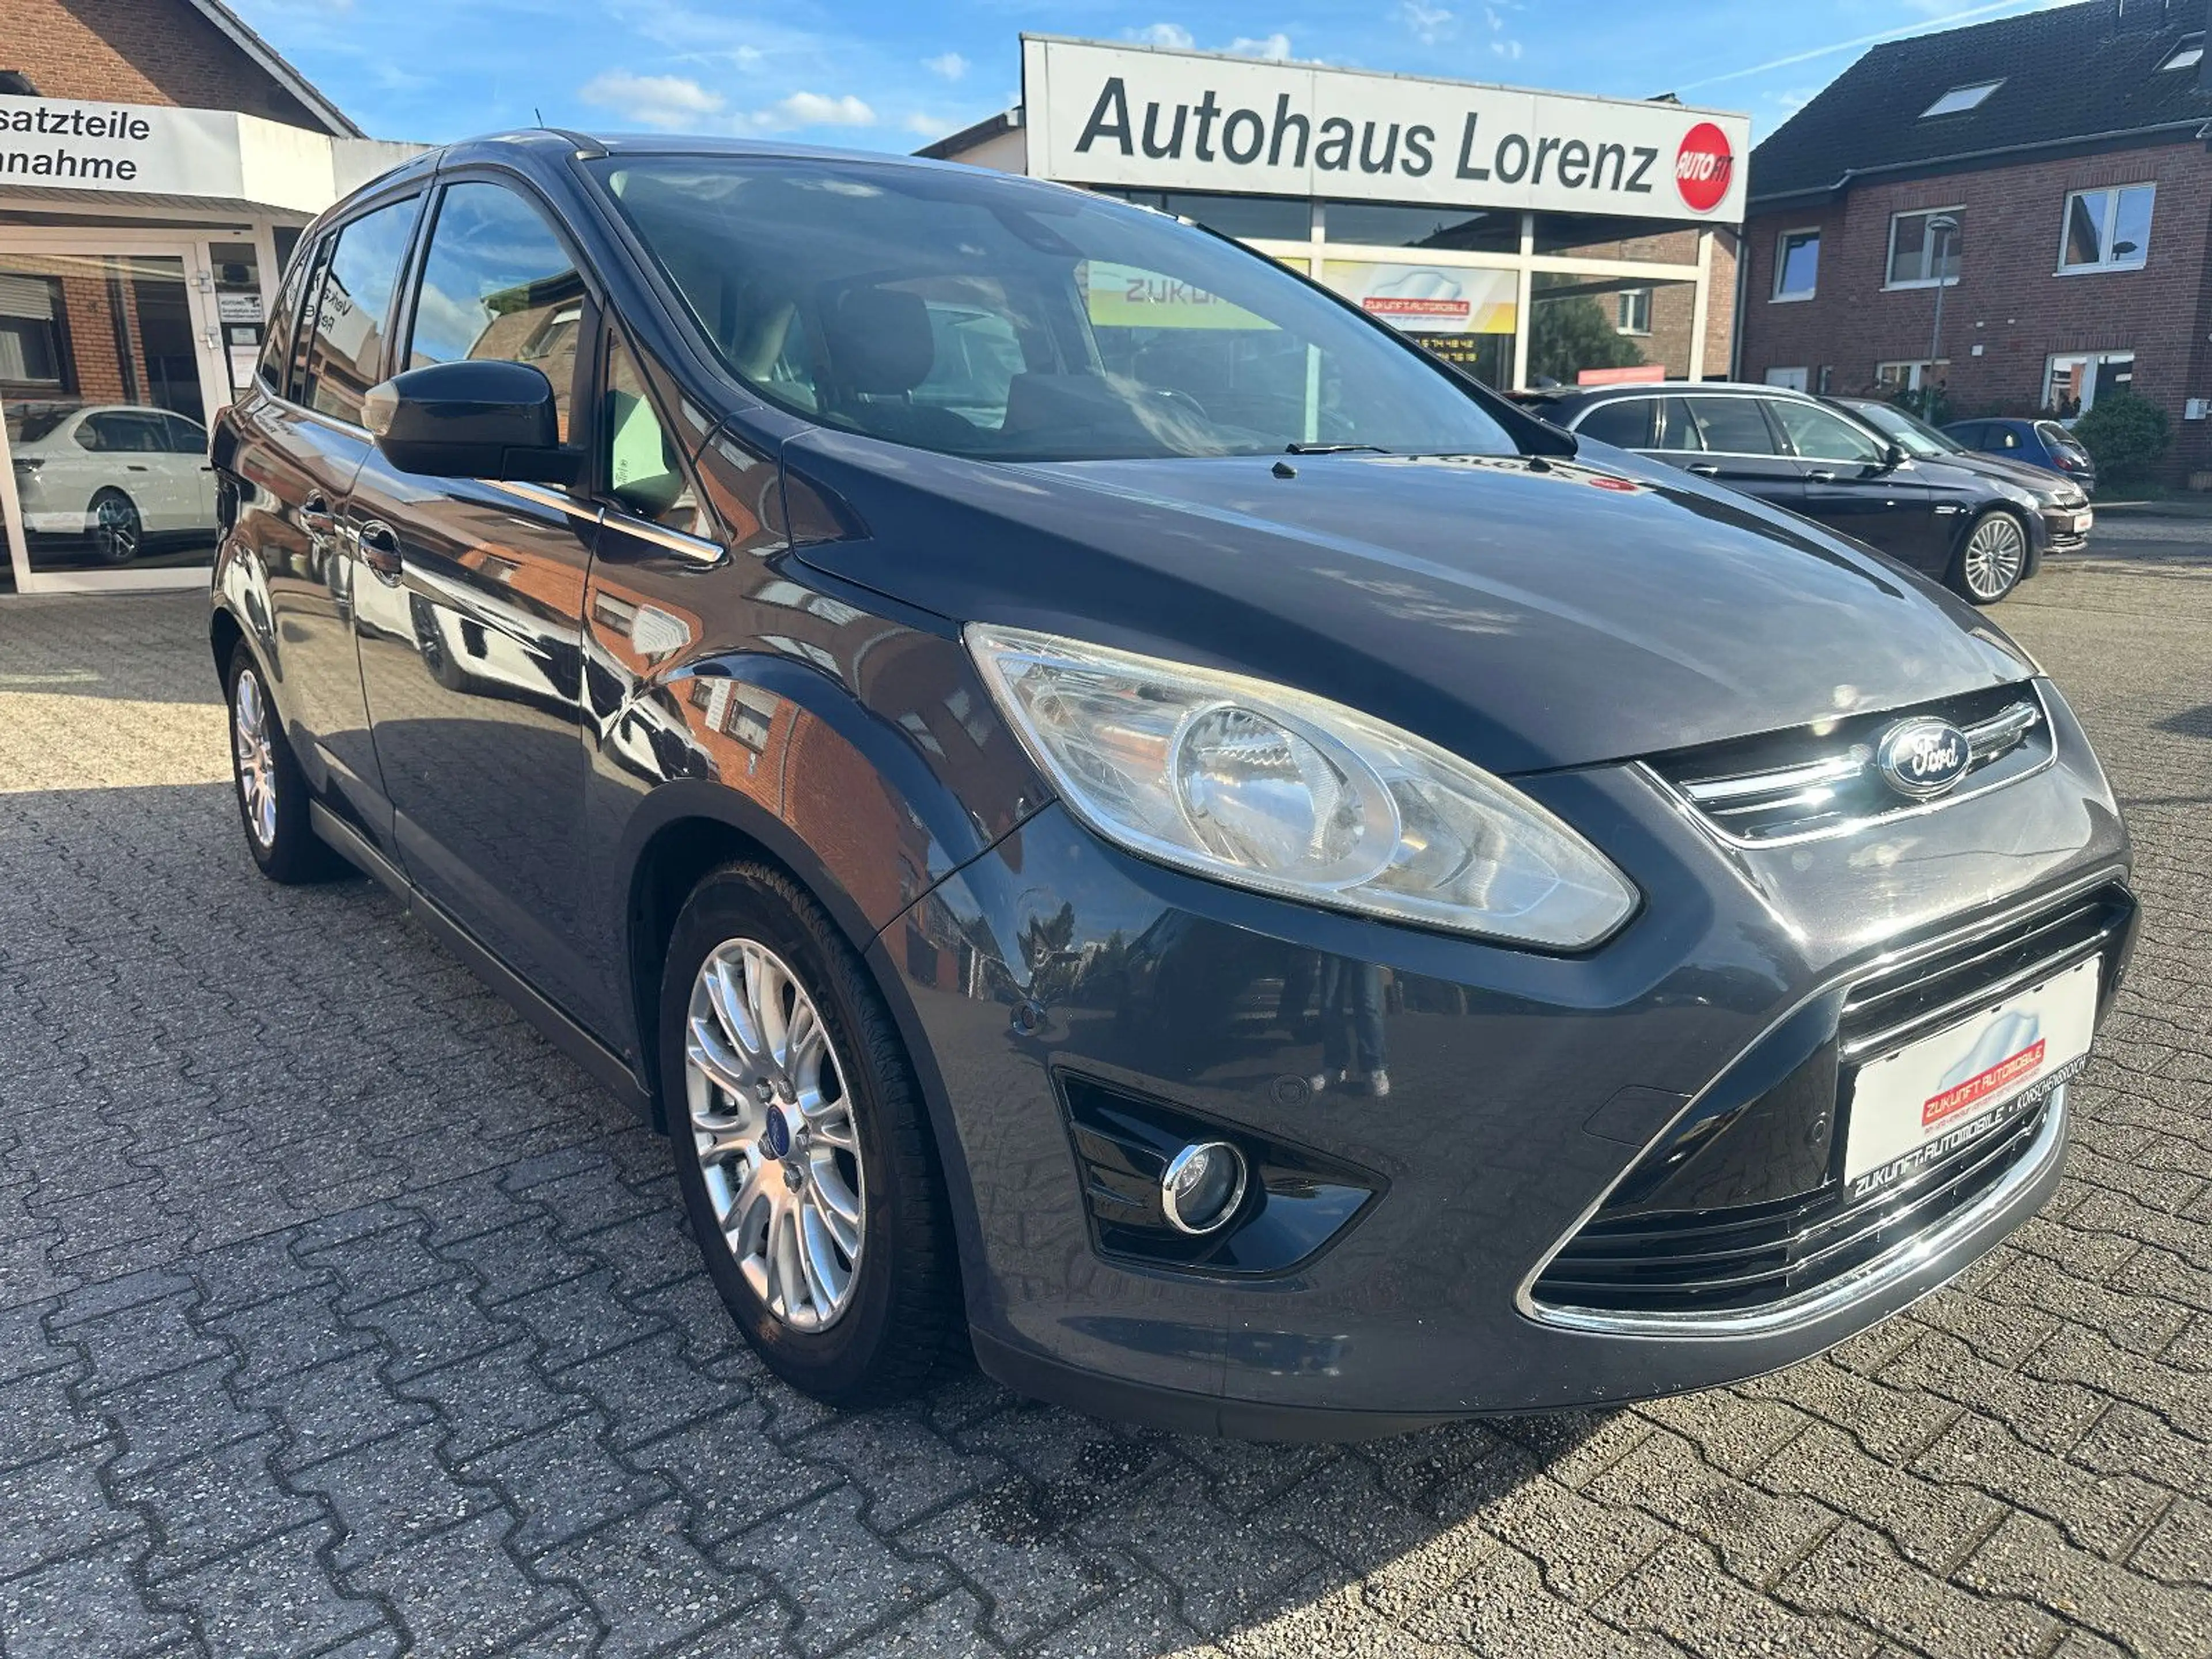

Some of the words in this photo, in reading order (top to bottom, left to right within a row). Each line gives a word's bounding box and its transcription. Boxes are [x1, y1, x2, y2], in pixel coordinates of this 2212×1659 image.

[1074, 77, 1435, 177] Autohaus
[1455, 111, 1659, 194] Lorenz
[0, 149, 137, 181] nahme
[1126, 279, 1217, 304] ZUKU
[1912, 738, 1959, 777] Ford
